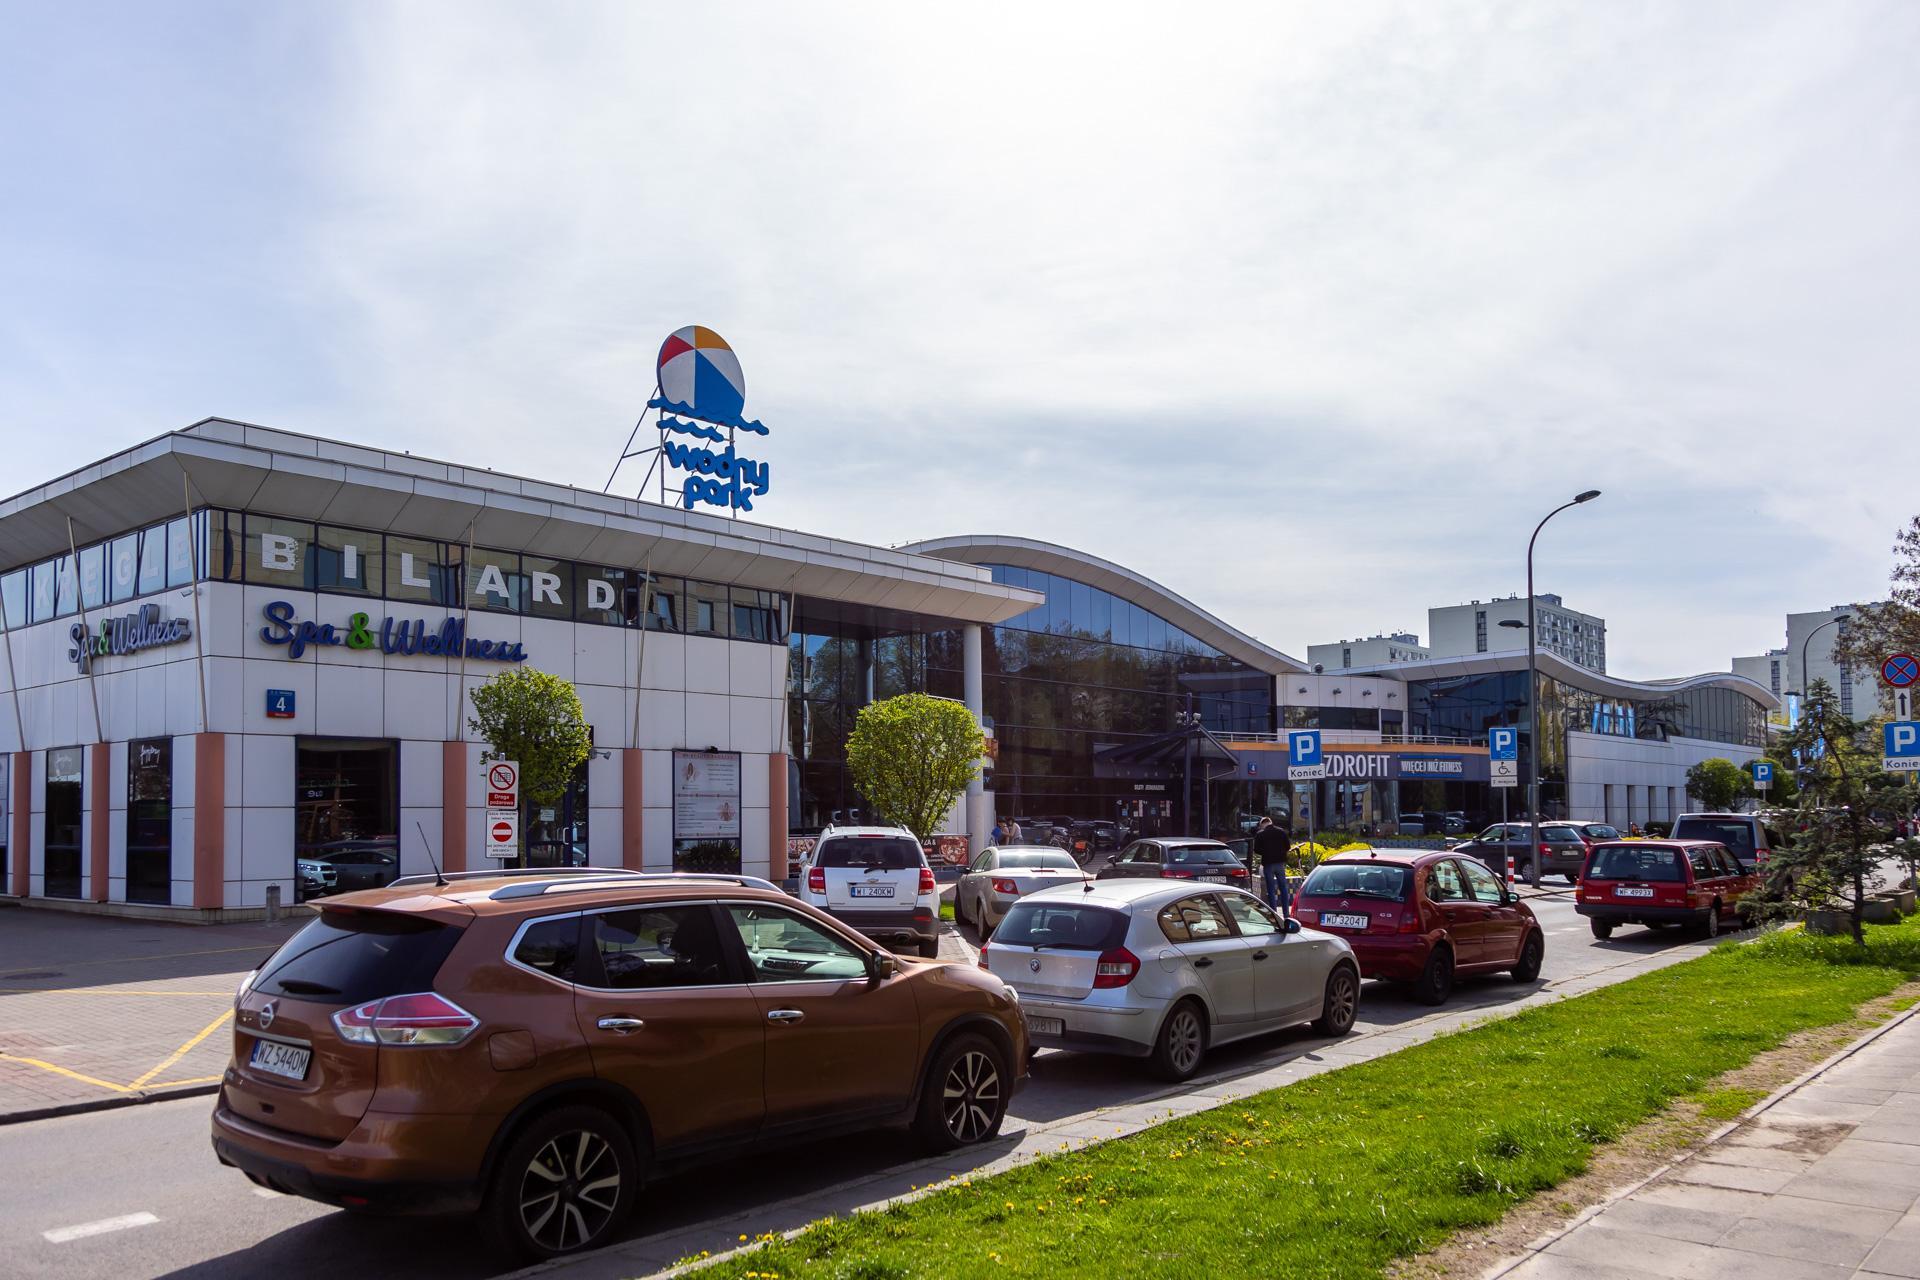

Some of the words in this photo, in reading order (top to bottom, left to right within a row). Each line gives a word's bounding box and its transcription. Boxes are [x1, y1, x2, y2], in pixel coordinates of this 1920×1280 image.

[664, 441, 769, 495] wodny
[683, 475, 753, 512] park
[262, 533, 615, 610] BILARD
[98, 618, 109, 655] &
[112, 604, 184, 655] Wellness
[260, 601, 340, 659] Spa
[346, 612, 374, 649] &
[381, 616, 528, 662] Wellness
[276, 697, 286, 711] 4
[1296, 735, 1314, 761] P
[1495, 731, 1511, 751] P
[1894, 725, 1915, 752] P
[1291, 765, 1322, 777] Koniec
[1324, 754, 1390, 777] ZDROFIT
[1758, 766, 1768, 779] P
[1886, 759, 1920, 768] Konie
[259, 1043, 273, 1064] WZ
[274, 1047, 308, 1073] 5440M
